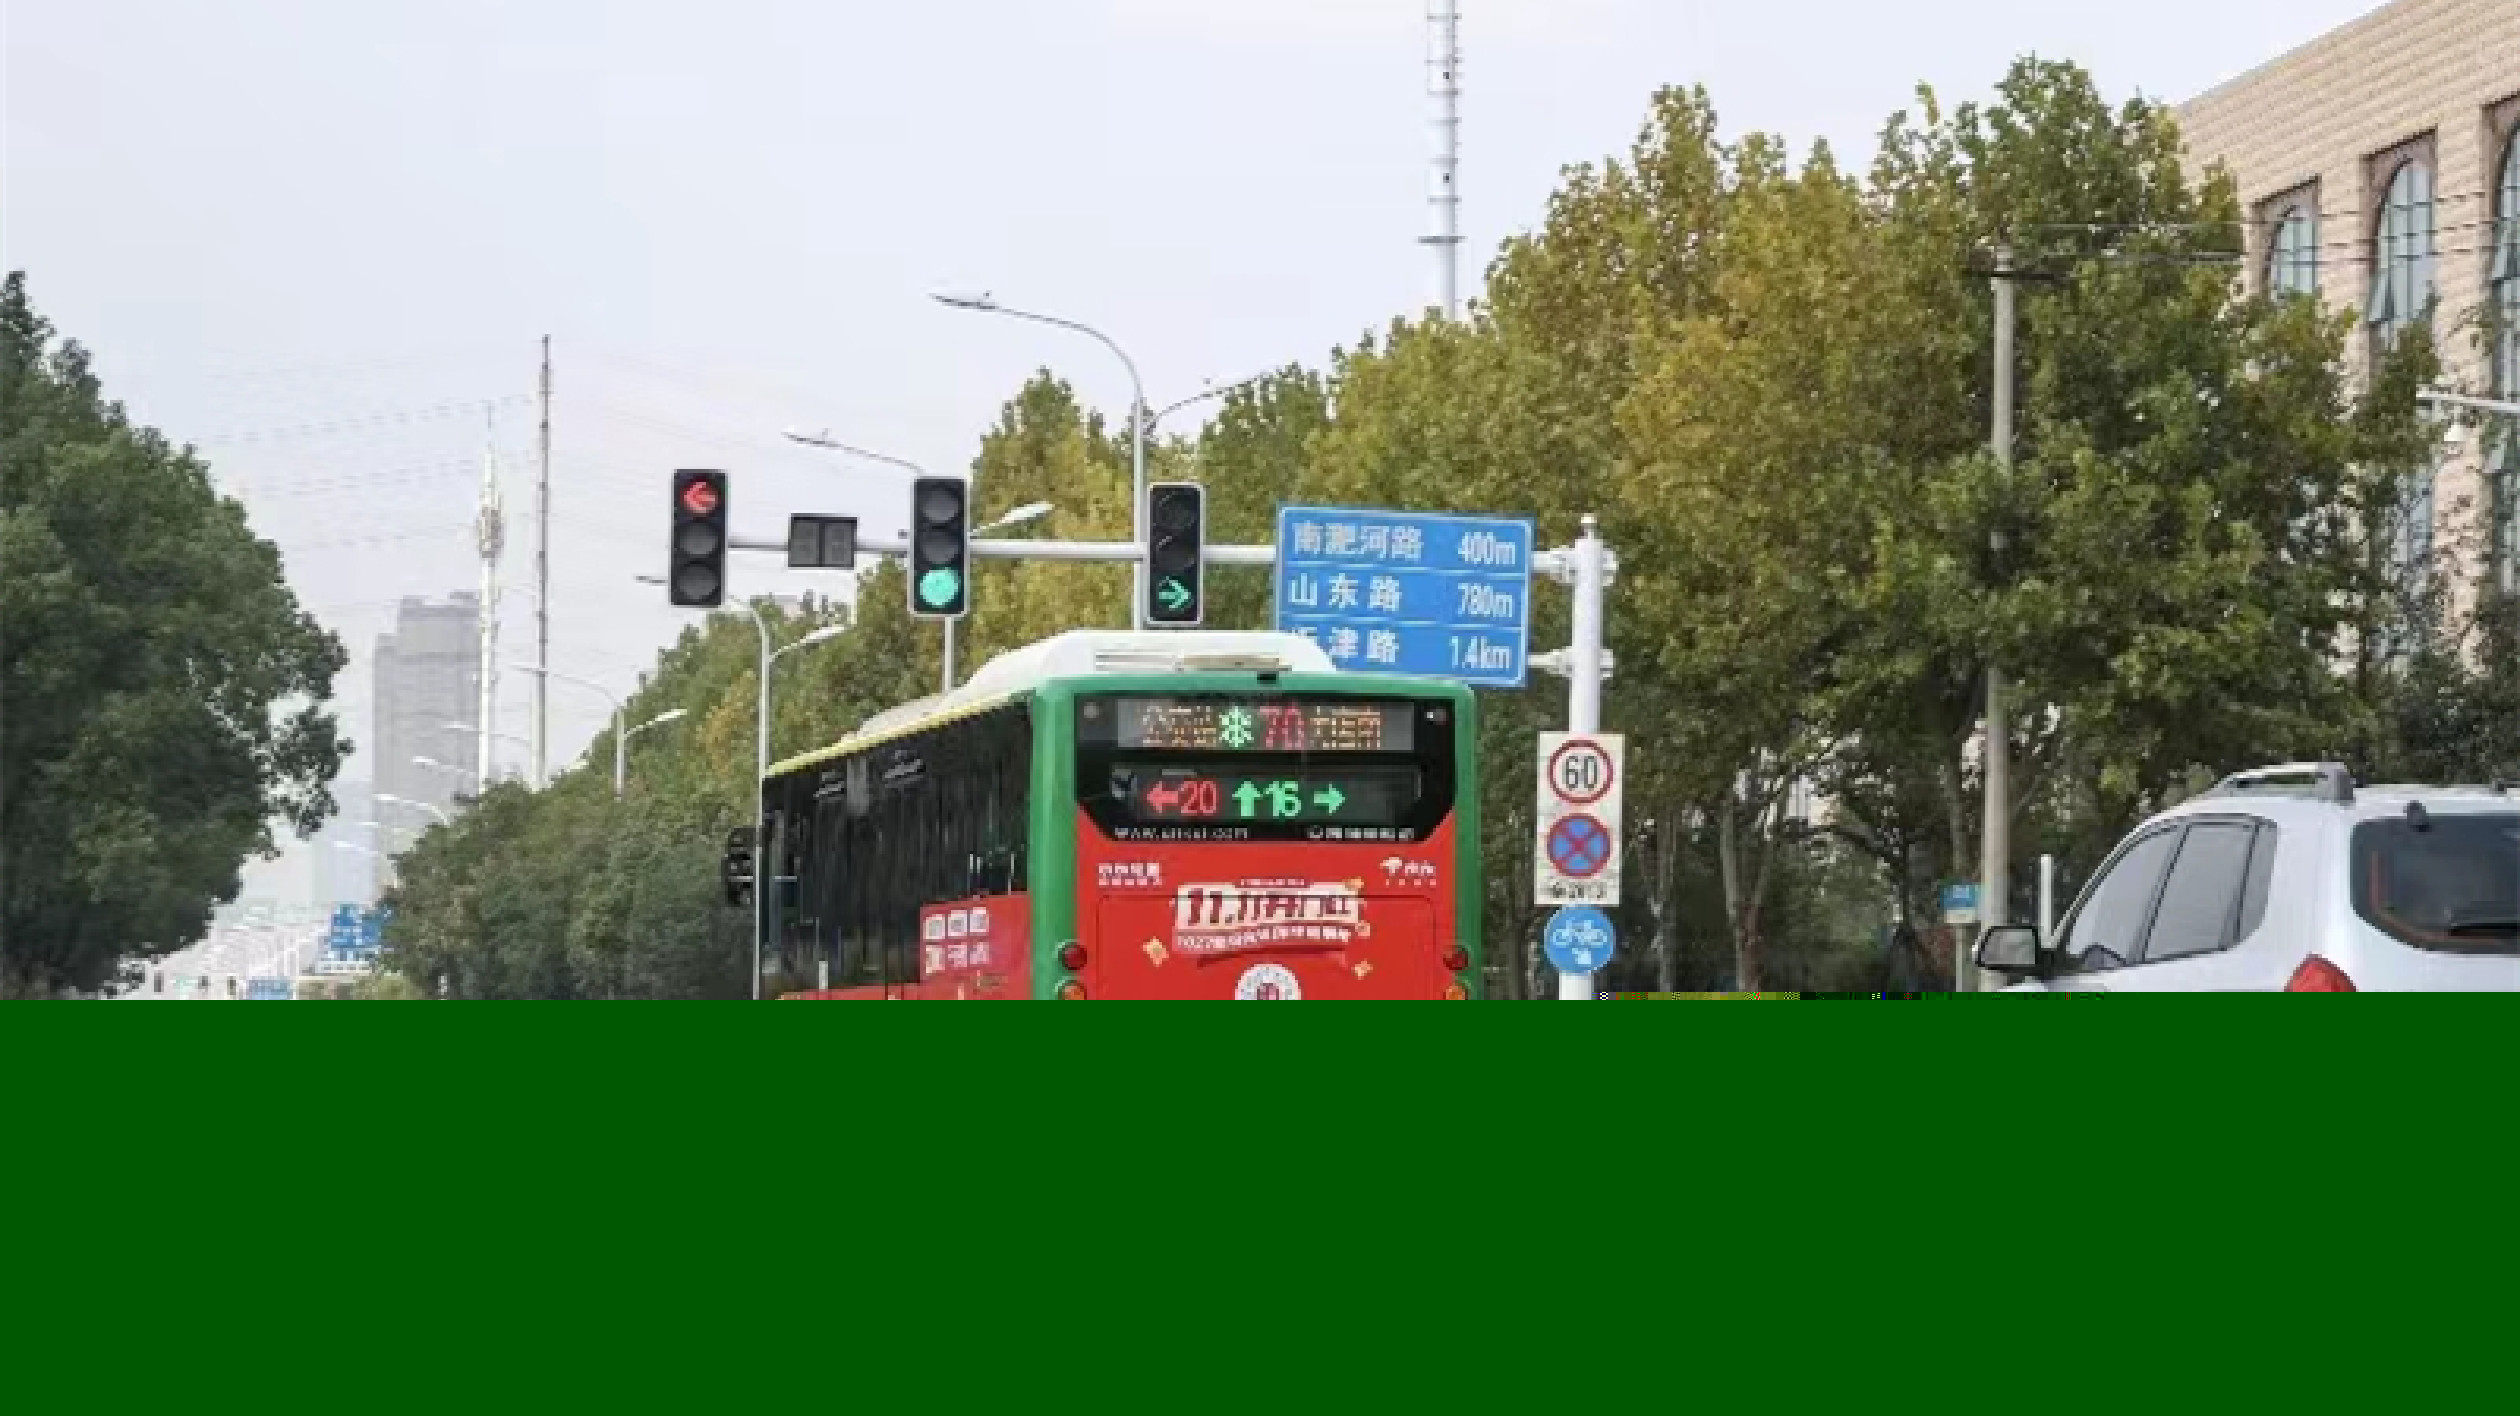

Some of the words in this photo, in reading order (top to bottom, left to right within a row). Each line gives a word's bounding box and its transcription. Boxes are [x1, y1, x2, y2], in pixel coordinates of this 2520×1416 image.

[1292, 520, 1423, 561] 南淝河路
[1458, 531, 1516, 566] 400m
[1288, 572, 1402, 612] 山东路
[1457, 582, 1513, 618] 780m
[1449, 635, 1512, 669] 1.4km
[1258, 704, 1307, 750] 70
[1562, 754, 1599, 791] 60
[1180, 780, 1219, 817] 20
[1264, 780, 1303, 818] 16
